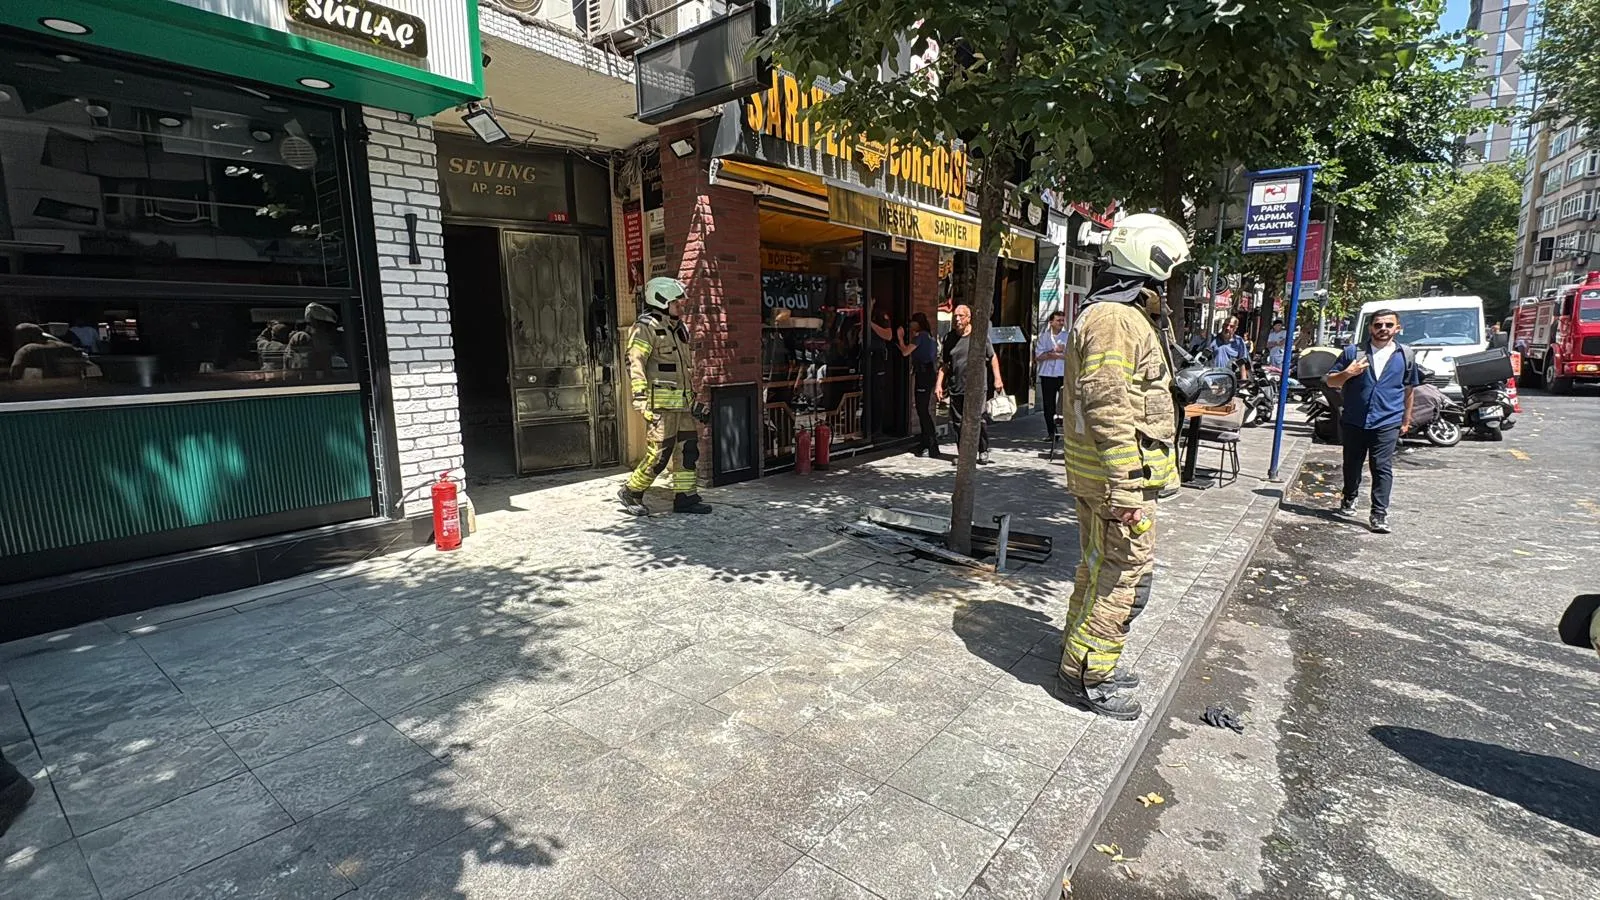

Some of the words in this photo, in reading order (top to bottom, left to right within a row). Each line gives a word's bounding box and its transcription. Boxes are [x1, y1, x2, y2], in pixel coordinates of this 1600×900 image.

[495, 184, 517, 196] 251
[1260, 204, 1286, 213] PARK
[1252, 212, 1294, 222] YAPMAK
[935, 219, 967, 240] SARIYER
[1247, 221, 1296, 231] YASAKTIR.
